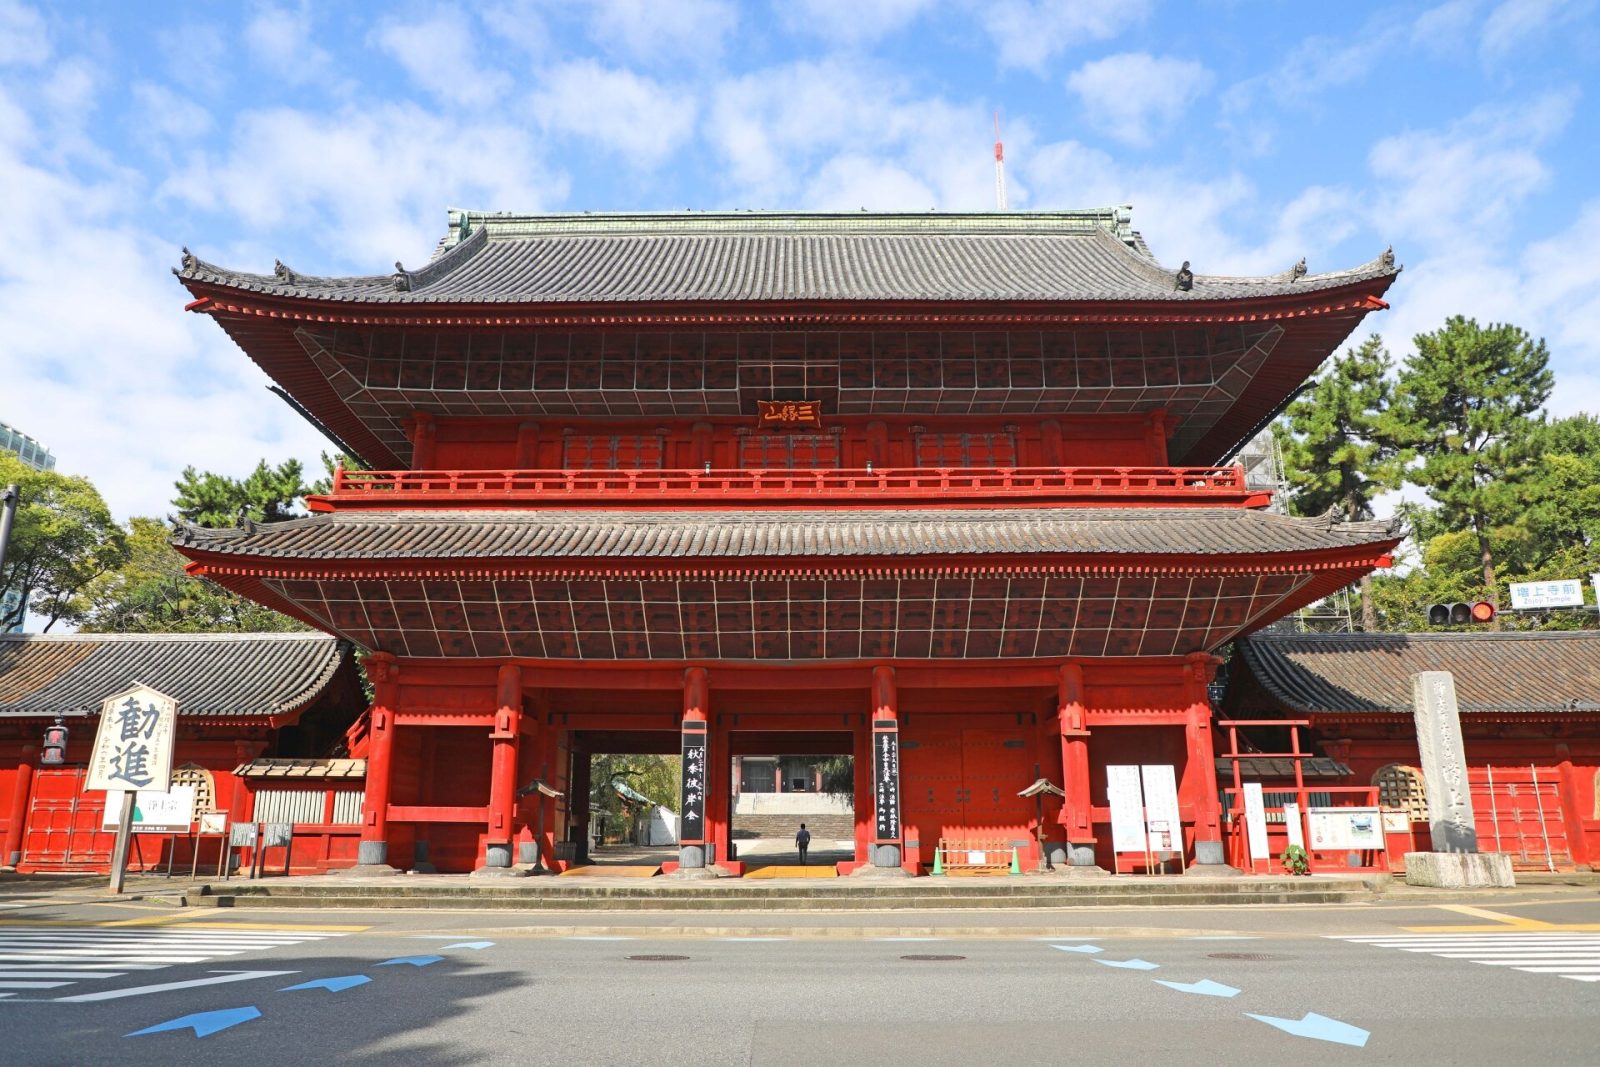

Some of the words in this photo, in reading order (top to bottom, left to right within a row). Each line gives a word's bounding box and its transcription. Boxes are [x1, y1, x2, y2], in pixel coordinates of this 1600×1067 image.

[1517, 584, 1575, 597] 増上寺前
[1546, 596, 1571, 604] Temple
[107, 696, 160, 788] 勧進
[684, 748, 700, 820] 秋季彼岸会
